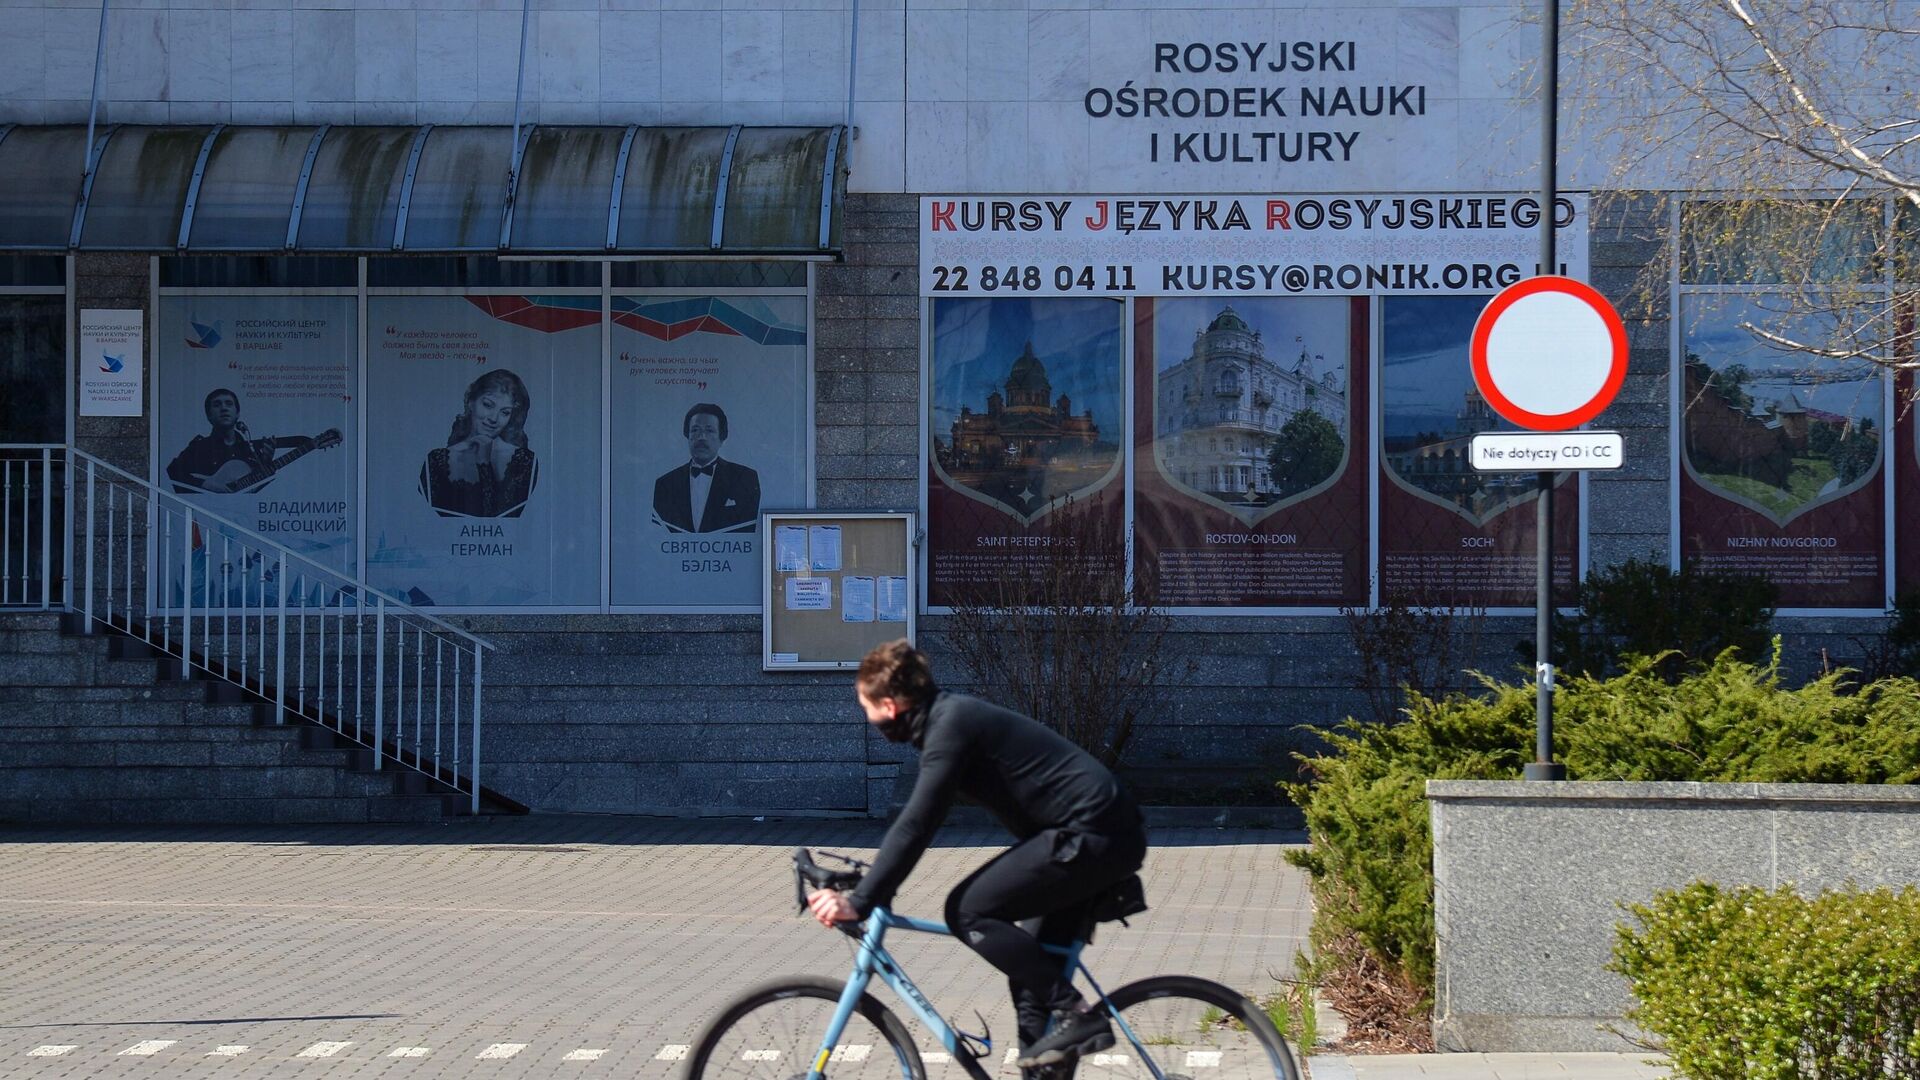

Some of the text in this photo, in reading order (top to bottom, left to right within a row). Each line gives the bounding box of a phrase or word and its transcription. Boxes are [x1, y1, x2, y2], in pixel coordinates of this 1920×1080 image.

[1155, 41, 1356, 73] ROSYJSKI
[1084, 80, 1426, 118] OŚRODEK NAUKI
[1150, 131, 1360, 163] I KULTURY
[931, 197, 1576, 236] KURSY JĘZYKA ROSYJSKIEGO
[931, 265, 969, 291] 22
[980, 265, 1042, 291] 848
[1054, 265, 1096, 291] 04
[1105, 265, 1136, 291] 11
[235, 319, 326, 328] РОССИЙСКИЙ ЦЕНТР
[235, 331, 320, 339] НАУКИ И КУЛЬТУРЫ
[235, 342, 282, 350] В ВАРШАВЕ
[1482, 445, 1612, 461] Nie dotyczy CD i CC
[258, 501, 347, 515] ВЛАДИМИР
[258, 516, 347, 534] ВЫСОЦКИЙ
[460, 525, 504, 538] АННА
[976, 536, 1008, 547] SAINT
[1205, 534, 1296, 544] ROSTOV-ON-DON
[1461, 537, 1495, 548] SOCHI
[1727, 537, 1837, 548] NIZHNY NOVGOROD
[451, 543, 513, 557] ГЕРМАН
[660, 541, 752, 554] СВЯТОСЛАВ
[681, 559, 732, 572] БЭЛЗА
